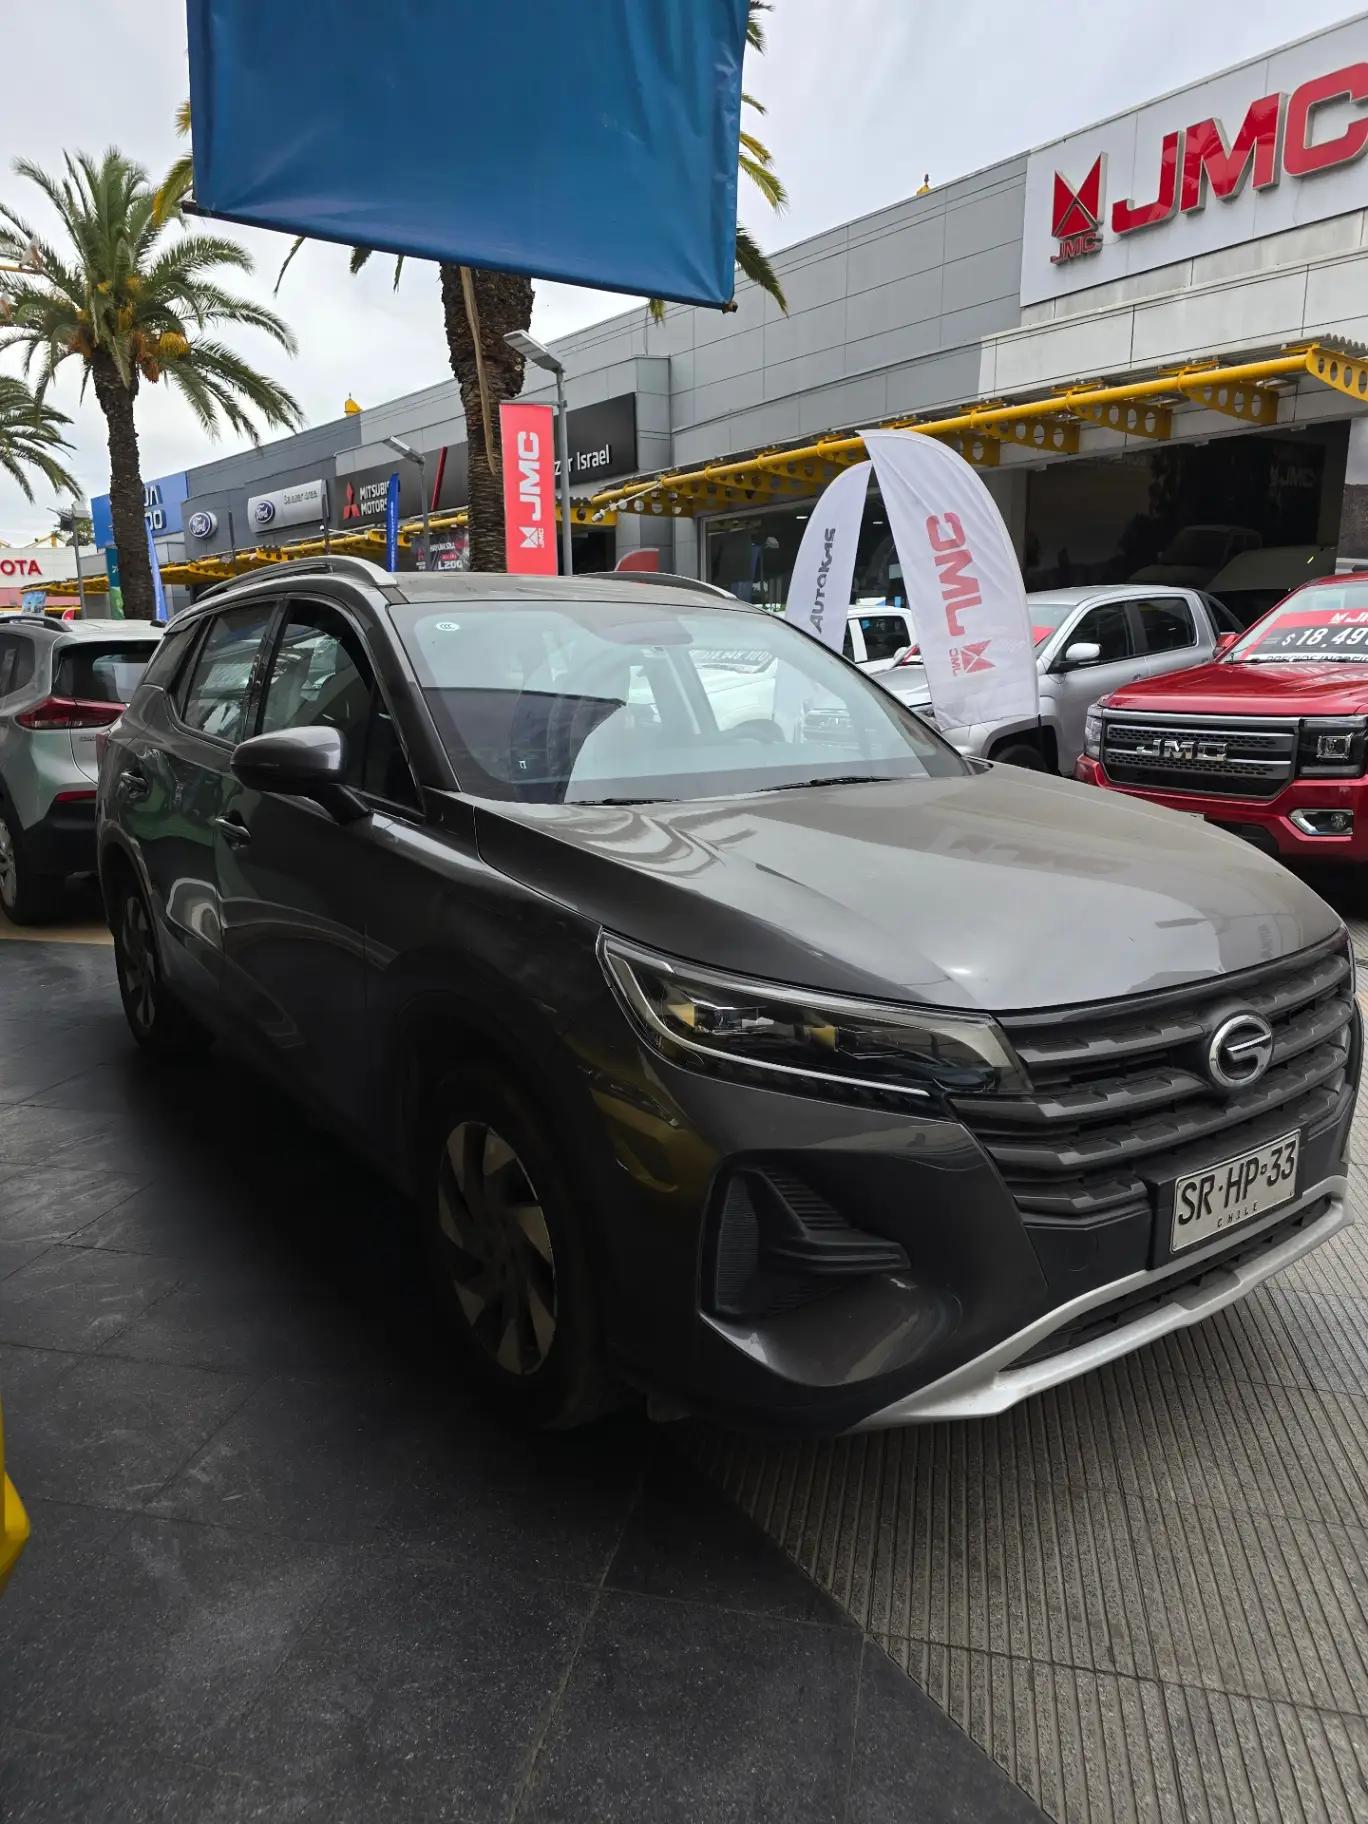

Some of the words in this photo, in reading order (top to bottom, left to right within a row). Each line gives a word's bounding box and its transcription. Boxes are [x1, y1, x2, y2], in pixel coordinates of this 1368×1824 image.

[1112, 61, 1368, 235] JMC
[1050, 231, 1101, 265] JMC
[576, 443, 610, 471] Israel
[517, 431, 542, 521] JMC
[809, 527, 836, 635] AUTOKAS
[1136, 738, 1228, 762] JMC
[1217, 1201, 1258, 1228] CHILE
